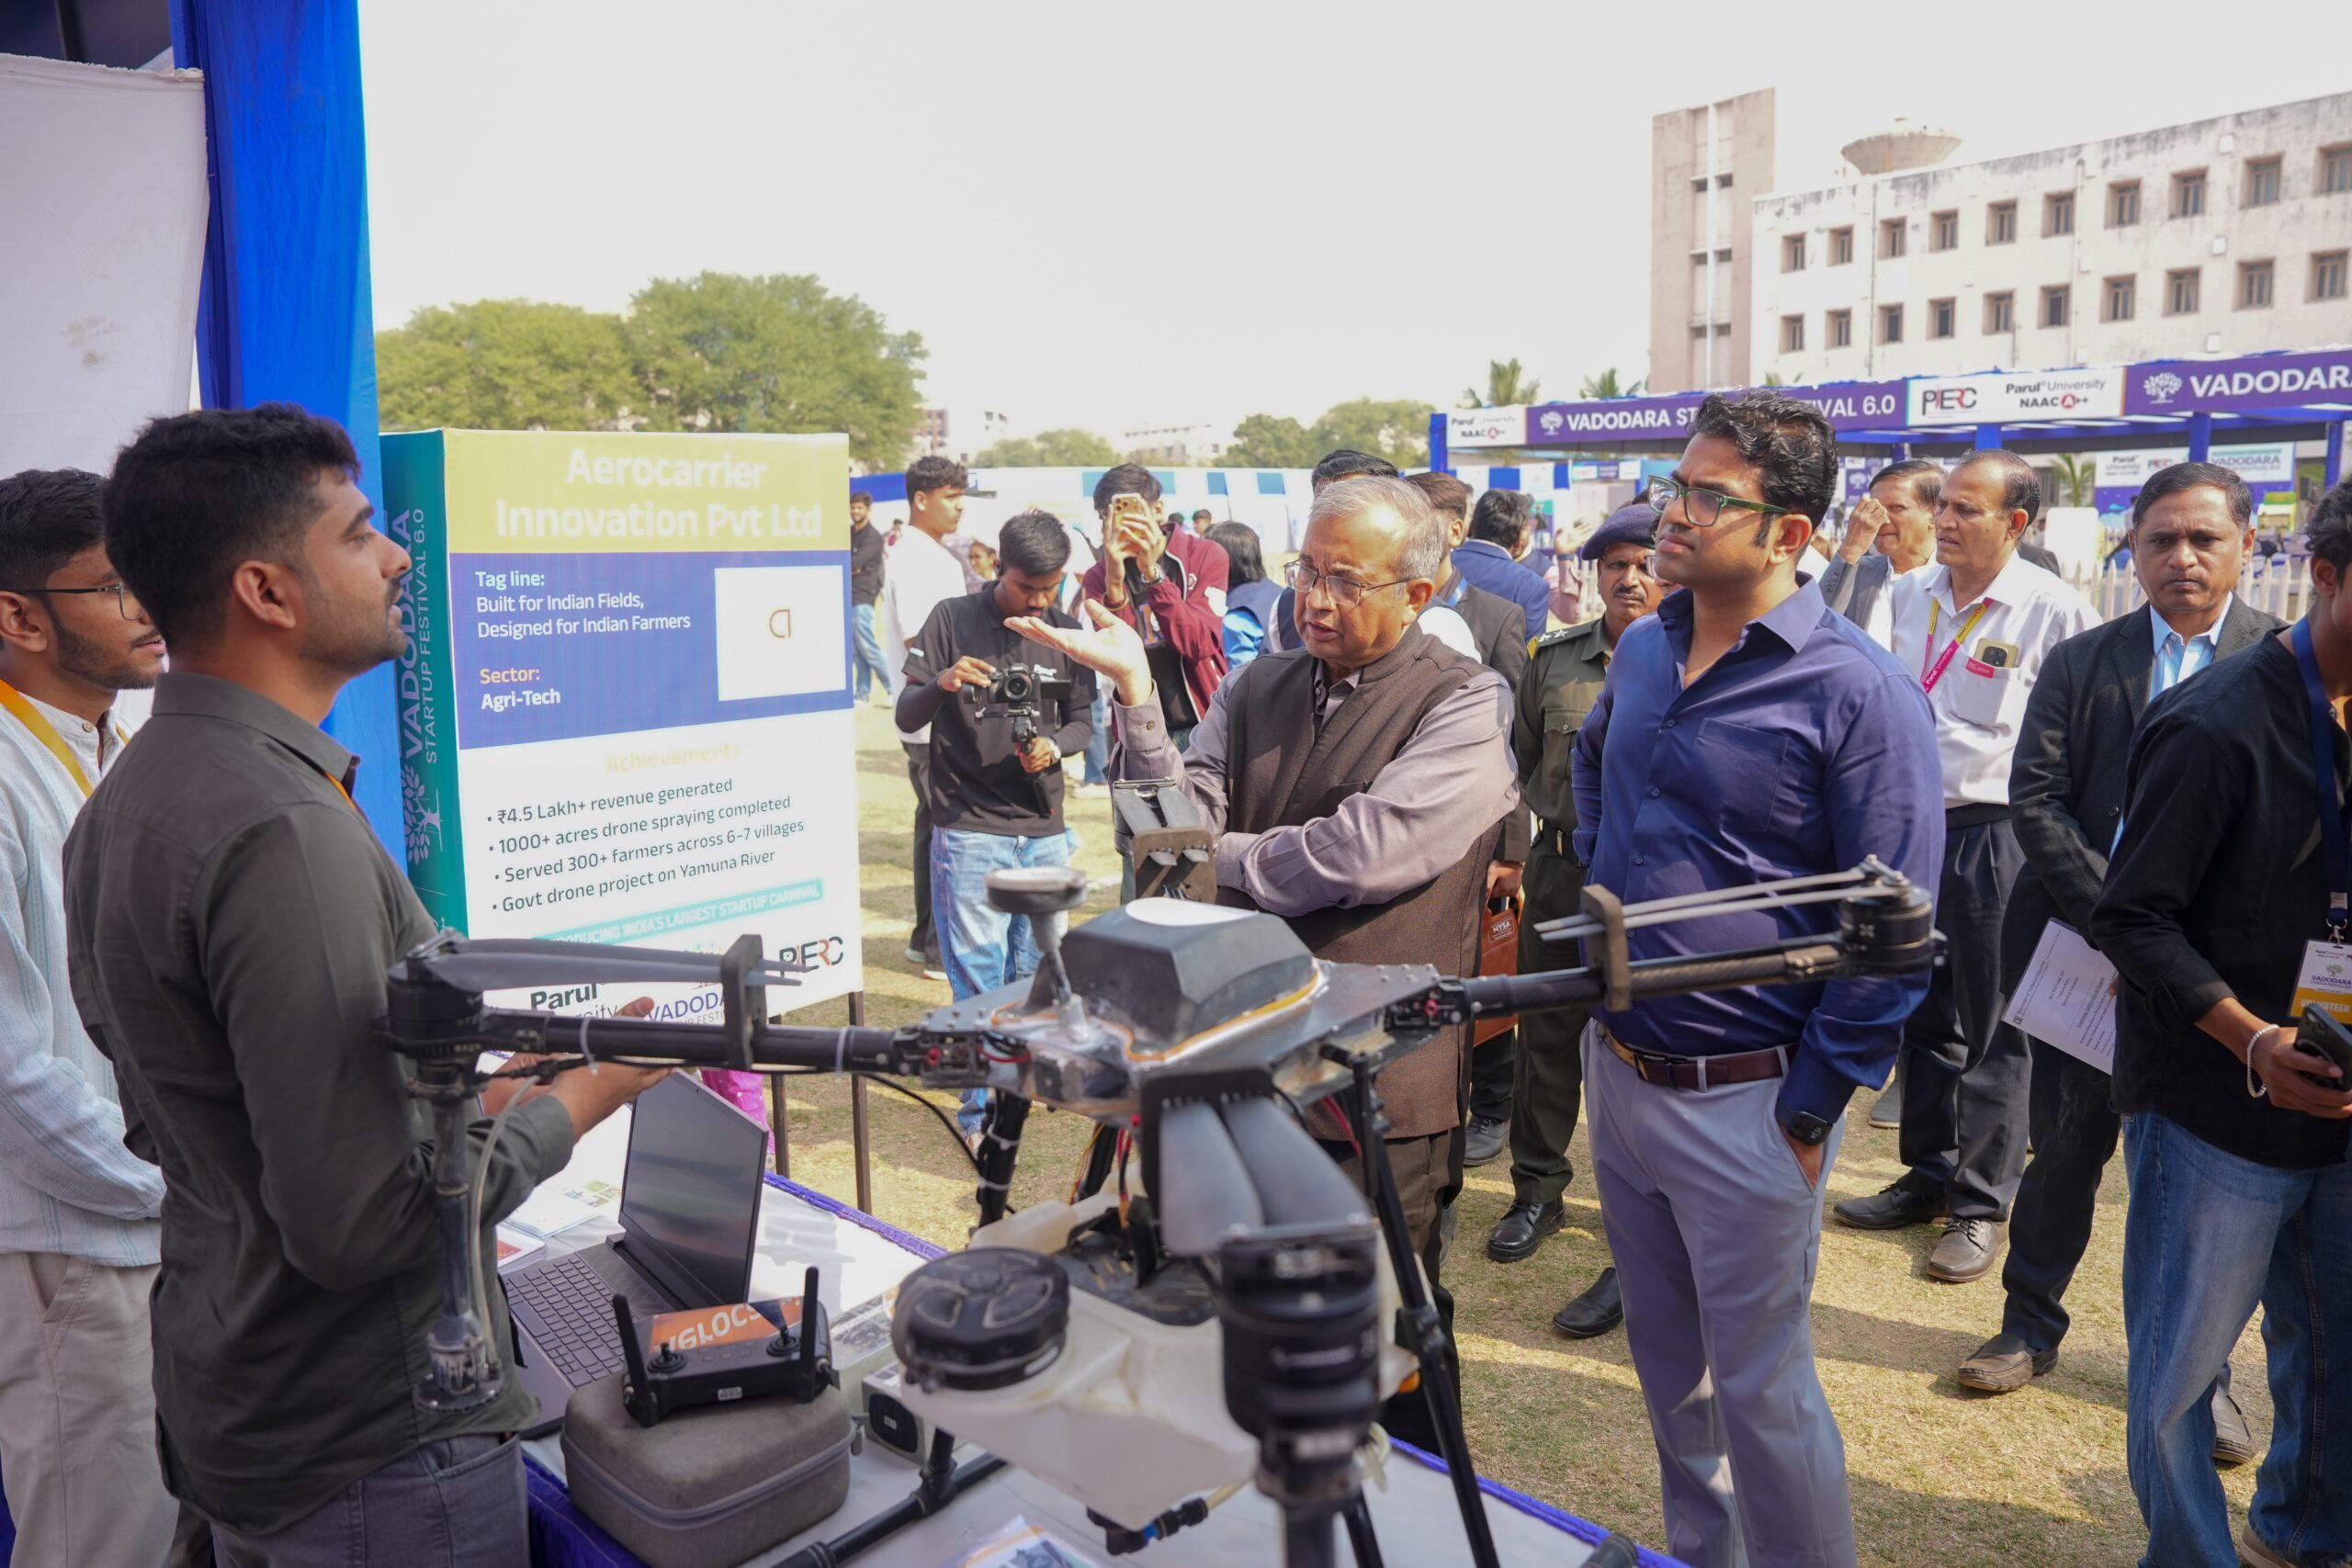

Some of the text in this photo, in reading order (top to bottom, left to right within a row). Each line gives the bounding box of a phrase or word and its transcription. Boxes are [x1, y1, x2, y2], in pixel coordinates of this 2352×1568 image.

[2006, 378, 2107, 394] Parul University
[2189, 366, 2352, 398] VADODAR
[1566, 409, 1670, 432] VADODARA
[1862, 394, 1895, 417] 6.0
[2019, 397, 2059, 409] NAAC
[1461, 429, 1486, 438] NAAC
[565, 447, 768, 490] Aerocarrier
[495, 499, 821, 538] Innovation Pvt Ltd
[475, 570, 545, 591] Tag line:
[477, 592, 644, 613] Built for Indian Fields,
[413, 508, 437, 764] STARTUP FESTIVAL 6.0
[478, 615, 691, 640] Designed for Indian Farmers
[480, 668, 540, 684] Sector:
[1926, 670, 1938, 684] Parul
[481, 689, 560, 713] Agri-Tech
[497, 778, 733, 824] ₹4.5 Lakh+ revenue generated
[498, 795, 791, 854] 1000+ acres drone spraying completed
[504, 819, 804, 883] Served 300+ farmers across 6-7 villages
[502, 850, 775, 912] Govt drone project on Yamuna River
[622, 914, 664, 938] INDIA'S
[666, 905, 717, 927] LARGEST
[718, 895, 768, 918] STARTUP
[2312, 976, 2351, 986] VADODARA
[530, 983, 597, 1010] Parul
[647, 992, 724, 1022] VADOD
